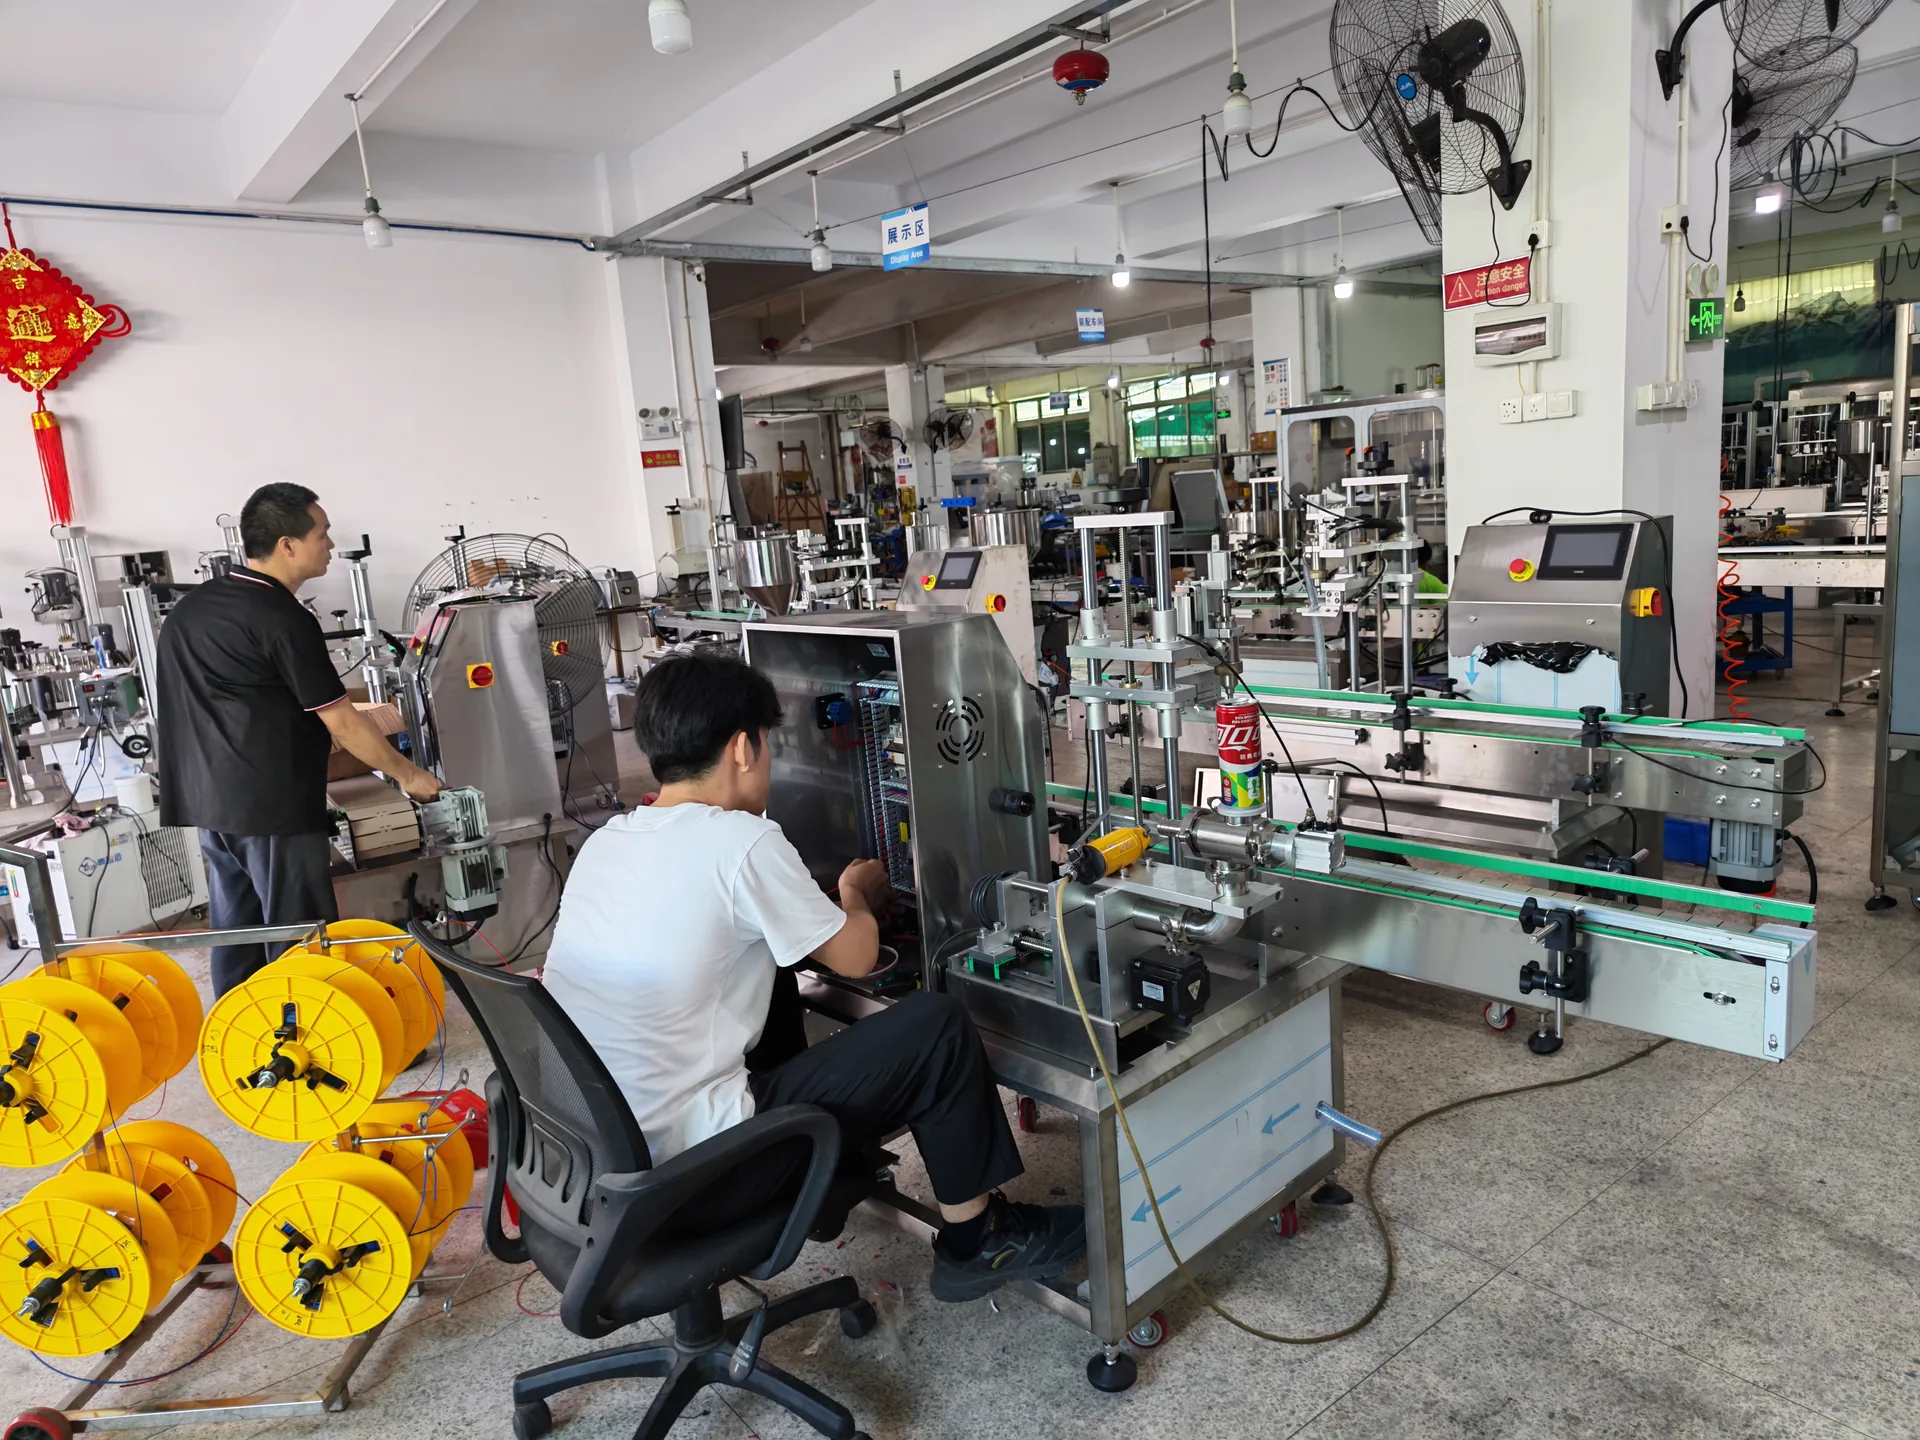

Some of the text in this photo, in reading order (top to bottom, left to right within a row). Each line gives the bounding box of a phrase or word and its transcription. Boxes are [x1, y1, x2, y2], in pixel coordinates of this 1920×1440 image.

[888, 219, 925, 245] 展示区
[890, 249, 924, 265] Display Area
[11, 274, 28, 290] 吉
[1477, 263, 1525, 287] 注意安全
[1475, 281, 1527, 298] Caution danger
